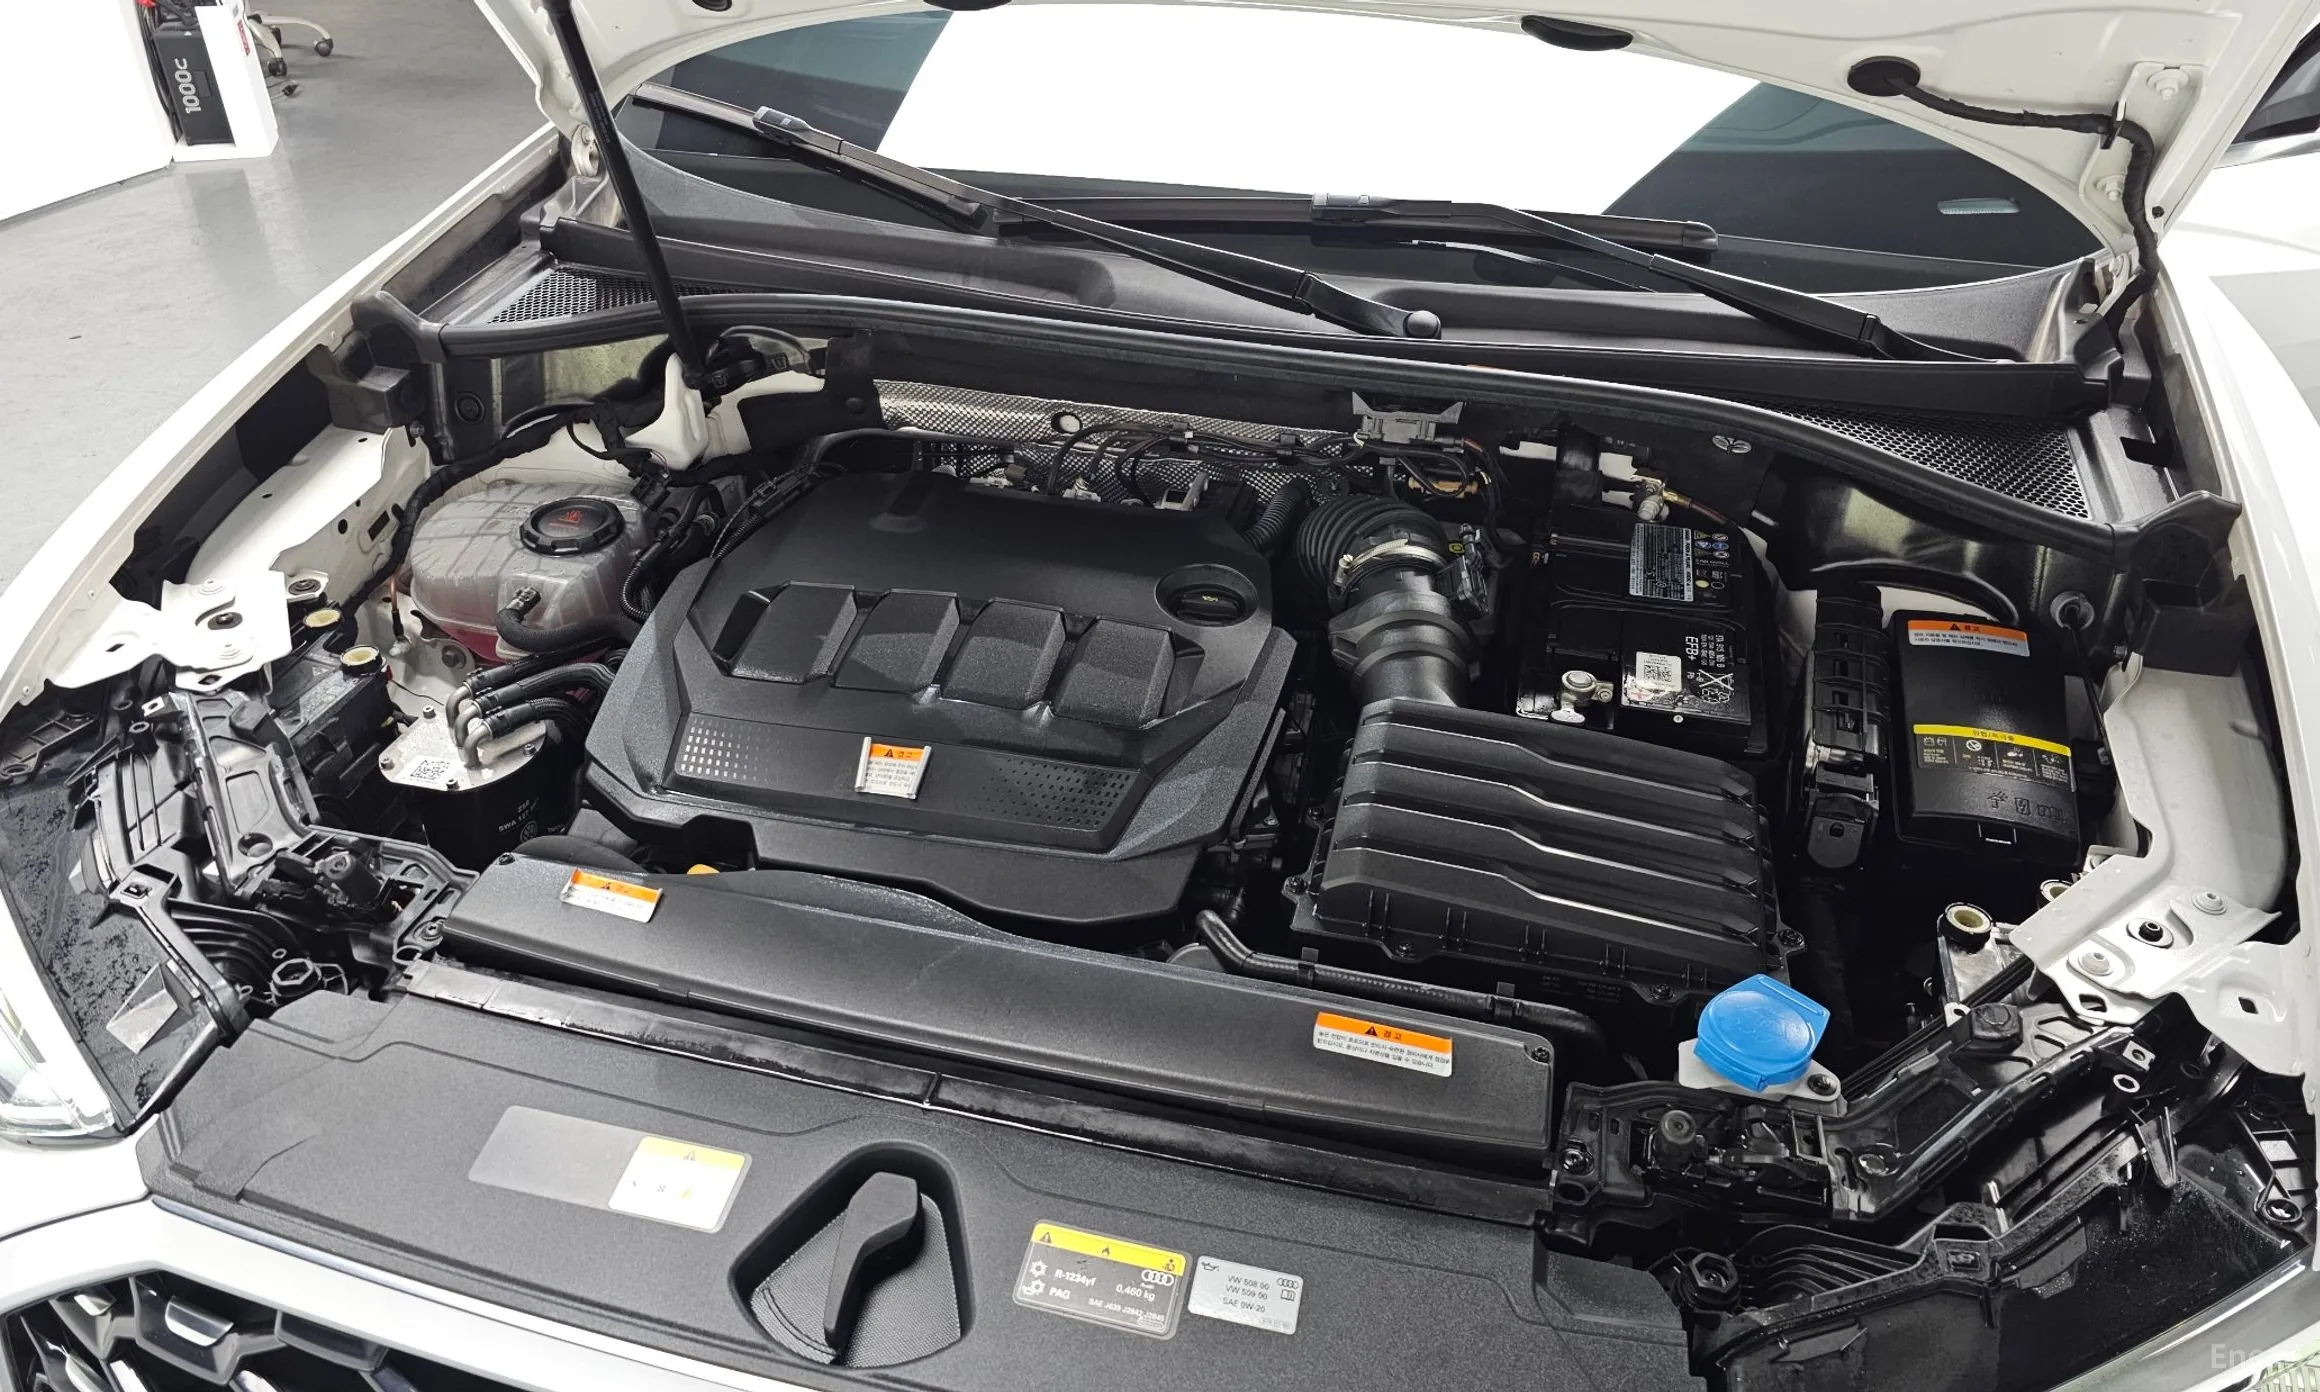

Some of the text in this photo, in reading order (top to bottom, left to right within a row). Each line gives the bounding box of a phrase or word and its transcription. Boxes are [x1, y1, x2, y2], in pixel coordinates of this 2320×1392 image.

[1685, 636, 1699, 661] EFB+
[1055, 1269, 1097, 1287] R-1234yf
[1228, 1274, 1242, 1284] VW
[1243, 1278, 1258, 1288] 508
[1049, 1287, 1071, 1299] PAG
[1143, 1290, 1156, 1302] kg
[1225, 1284, 1268, 1300] VW 509 00
[1222, 1297, 1266, 1313] SAE 0W-20
